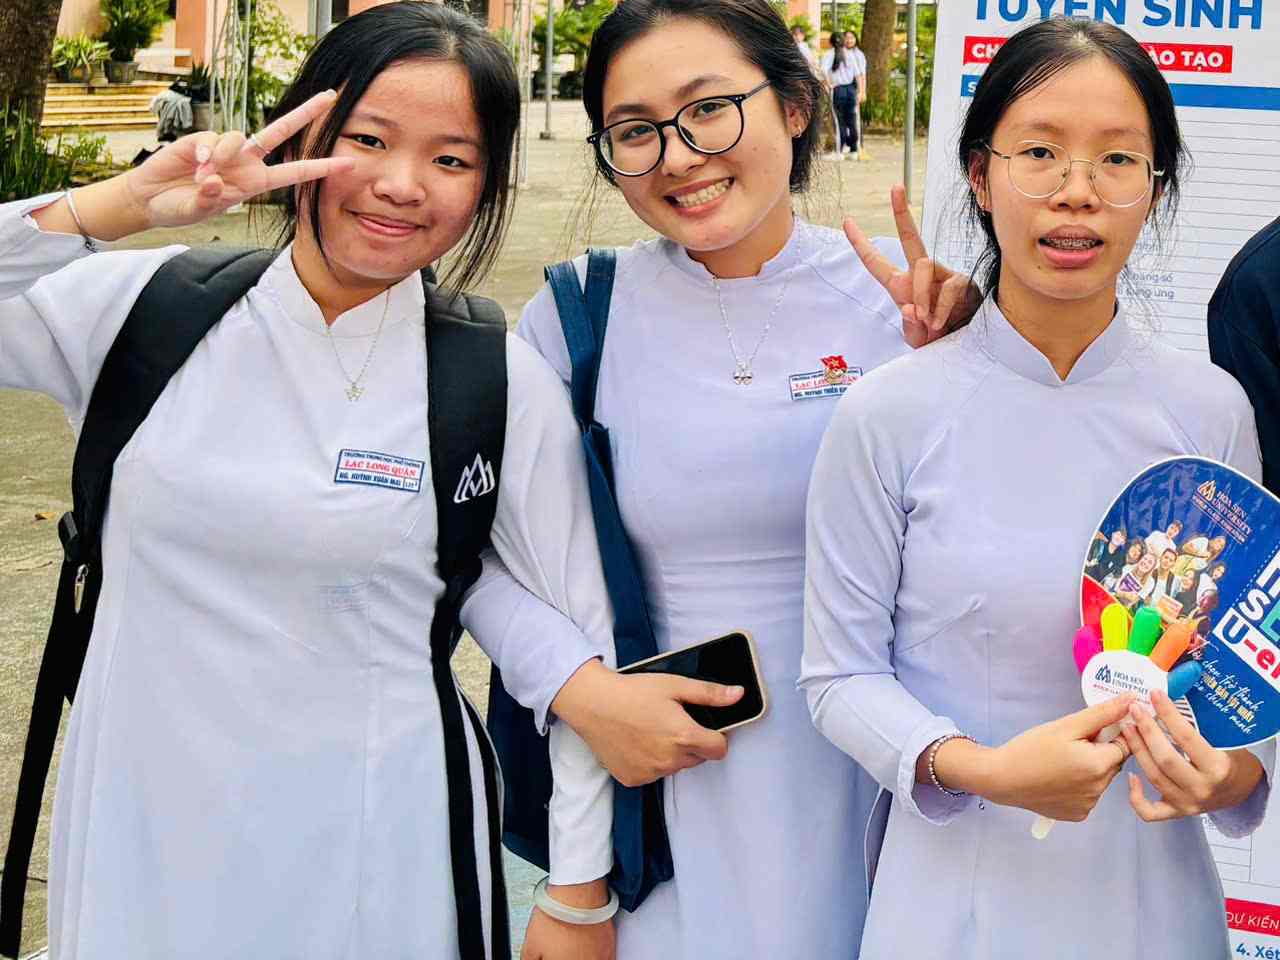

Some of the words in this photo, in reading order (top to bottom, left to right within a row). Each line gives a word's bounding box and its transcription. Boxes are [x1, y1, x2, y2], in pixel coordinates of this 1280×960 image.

[1181, 50, 1224, 71] TẠO
[366, 462, 390, 472] LONG
[1236, 942, 1250, 956] 4.
[1254, 944, 1280, 960] Xét
